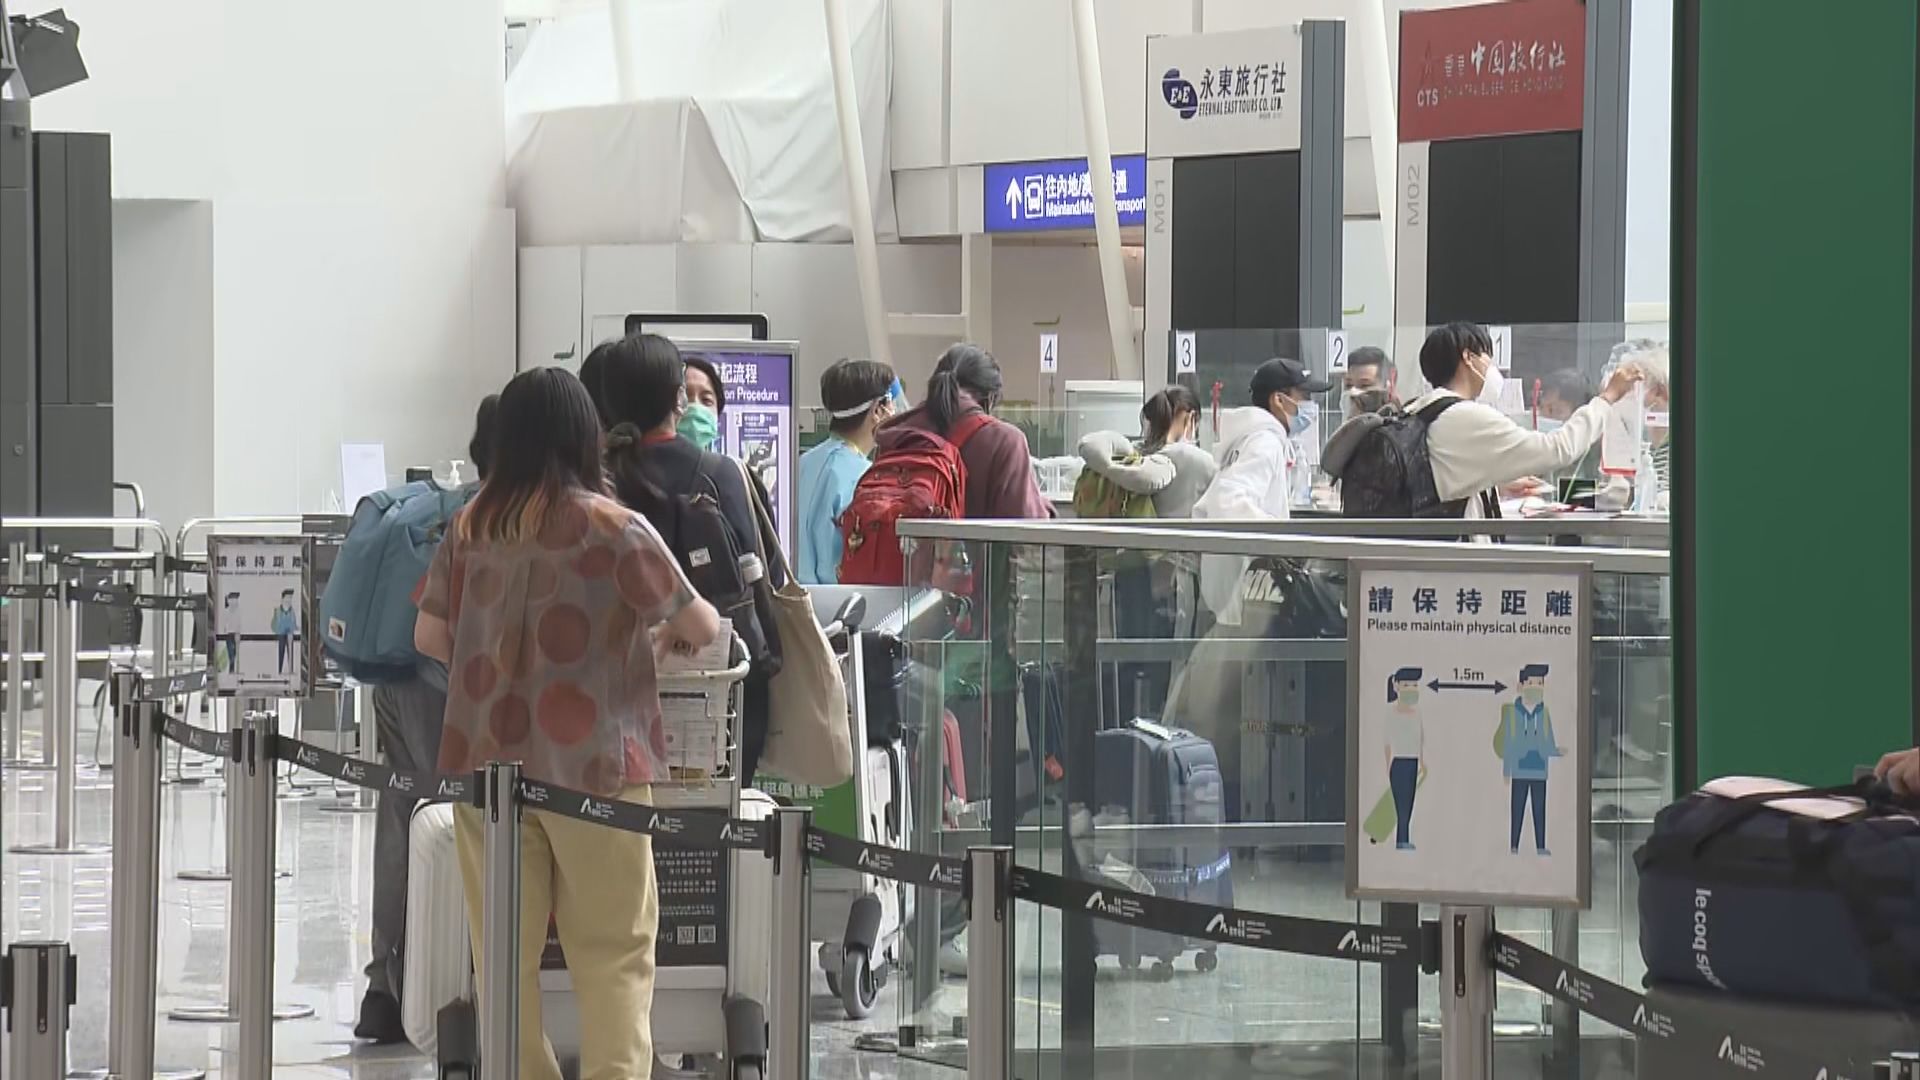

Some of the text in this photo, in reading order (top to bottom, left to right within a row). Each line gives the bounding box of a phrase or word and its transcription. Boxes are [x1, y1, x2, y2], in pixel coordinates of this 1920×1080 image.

[1200, 61, 1286, 100] 永東旅行社
[1224, 100, 1238, 115] EAST
[1239, 98, 1258, 114] TOURS
[1417, 88, 1439, 107] CTS
[1115, 196, 1146, 215] ransport
[1154, 180, 1165, 233] M01
[1407, 164, 1420, 226] M02
[1044, 339, 1053, 368] 4
[1182, 338, 1192, 367] 3
[1333, 336, 1344, 367] 2
[1496, 337, 1503, 365] 1
[711, 362, 757, 384] 記流程
[737, 387, 779, 401] Procedure
[1368, 586, 1572, 617] 請保持距離
[1367, 618, 1571, 636] Please maintain physical distance
[1453, 668, 1484, 681] 1.5m
[1692, 910, 1707, 951] coq
